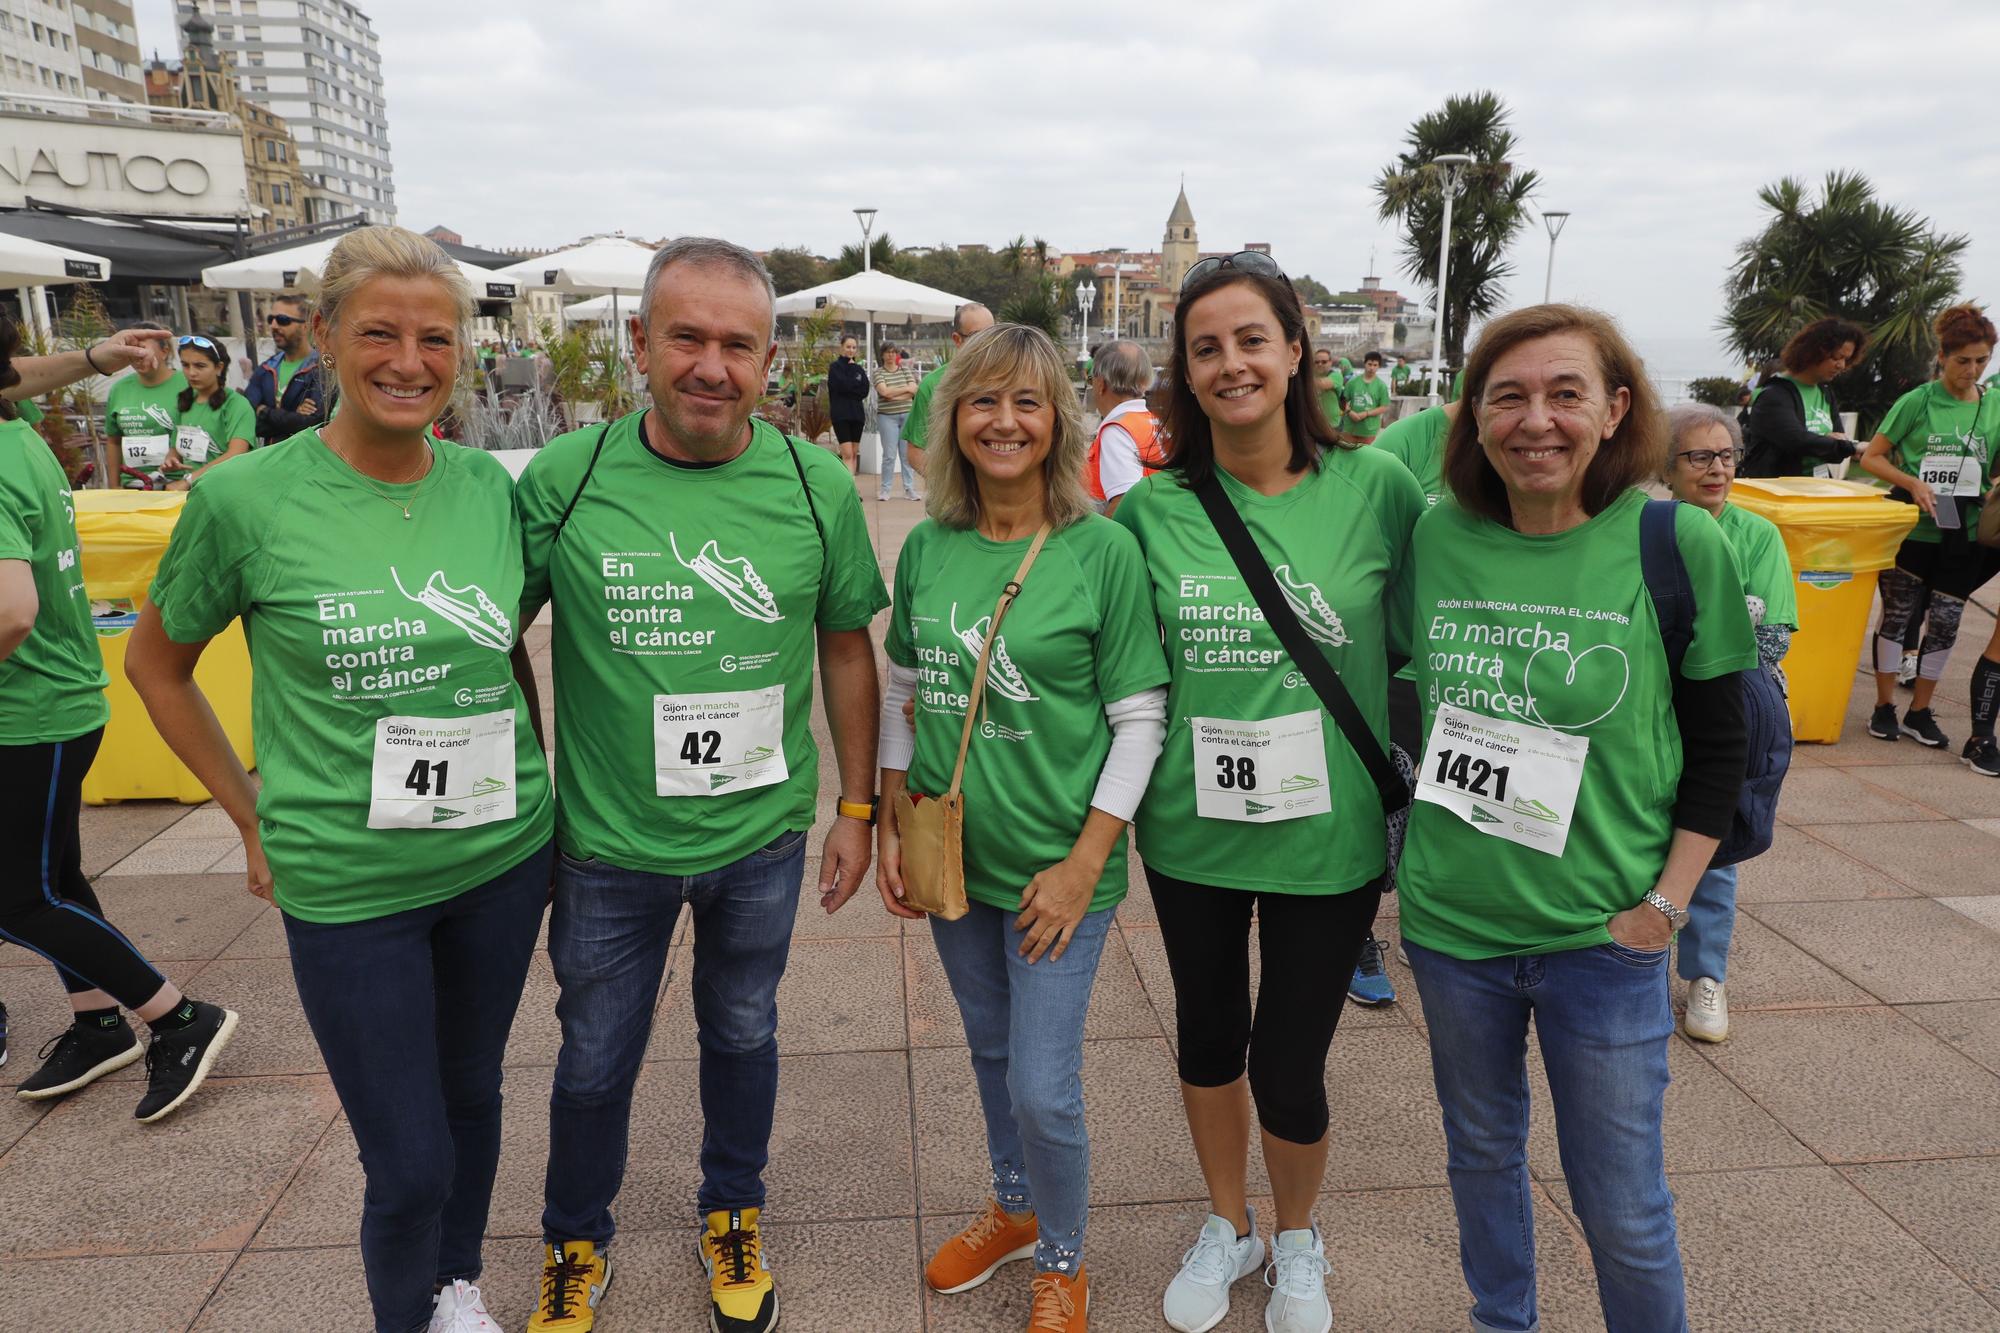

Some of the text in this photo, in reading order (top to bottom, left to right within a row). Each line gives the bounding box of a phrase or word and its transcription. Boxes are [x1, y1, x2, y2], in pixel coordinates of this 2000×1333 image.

[179, 438, 193, 450] 152
[1927, 435, 1942, 444] En
[1927, 443, 1962, 452] marcha
[128, 446, 147, 458] 132
[1922, 470, 1959, 484] 1366
[602, 557, 634, 577] En
[605, 580, 694, 601] marcha
[1180, 580, 1209, 598] En
[318, 599, 356, 621] En
[607, 605, 682, 623] contra
[1179, 602, 1265, 621] marcha
[1437, 599, 1631, 626] GIJÓN EN MARCHA CONTRA EL CÁNCER
[322, 617, 428, 646] marcha
[609, 626, 716, 647] el cáncer
[1180, 625, 1252, 643] contra
[1428, 615, 1570, 652] En marcha
[325, 645, 415, 669] contra
[1184, 645, 1283, 664] el cáncer
[1428, 651, 1504, 679] contra
[331, 663, 452, 691] el cáncer
[1430, 677, 1537, 717] el cáncer
[662, 703, 688, 714] Gijón
[703, 701, 740, 710] marcha
[662, 710, 740, 722] contra el cáncer
[387, 724, 416, 738] Gijón
[418, 729, 433, 737] en
[436, 727, 471, 737] marcha
[1200, 725, 1223, 736] Gijón
[1236, 729, 1271, 739] marcha
[1445, 716, 1520, 745] Gijón en marcha
[386, 737, 471, 748] contra el cáncer
[680, 730, 722, 765] 42
[1201, 736, 1272, 748] contra el cáncer
[1442, 727, 1519, 756] contra el cáncer
[405, 759, 449, 797] 41
[1216, 754, 1257, 791] 38
[1435, 748, 1510, 802] 1421
